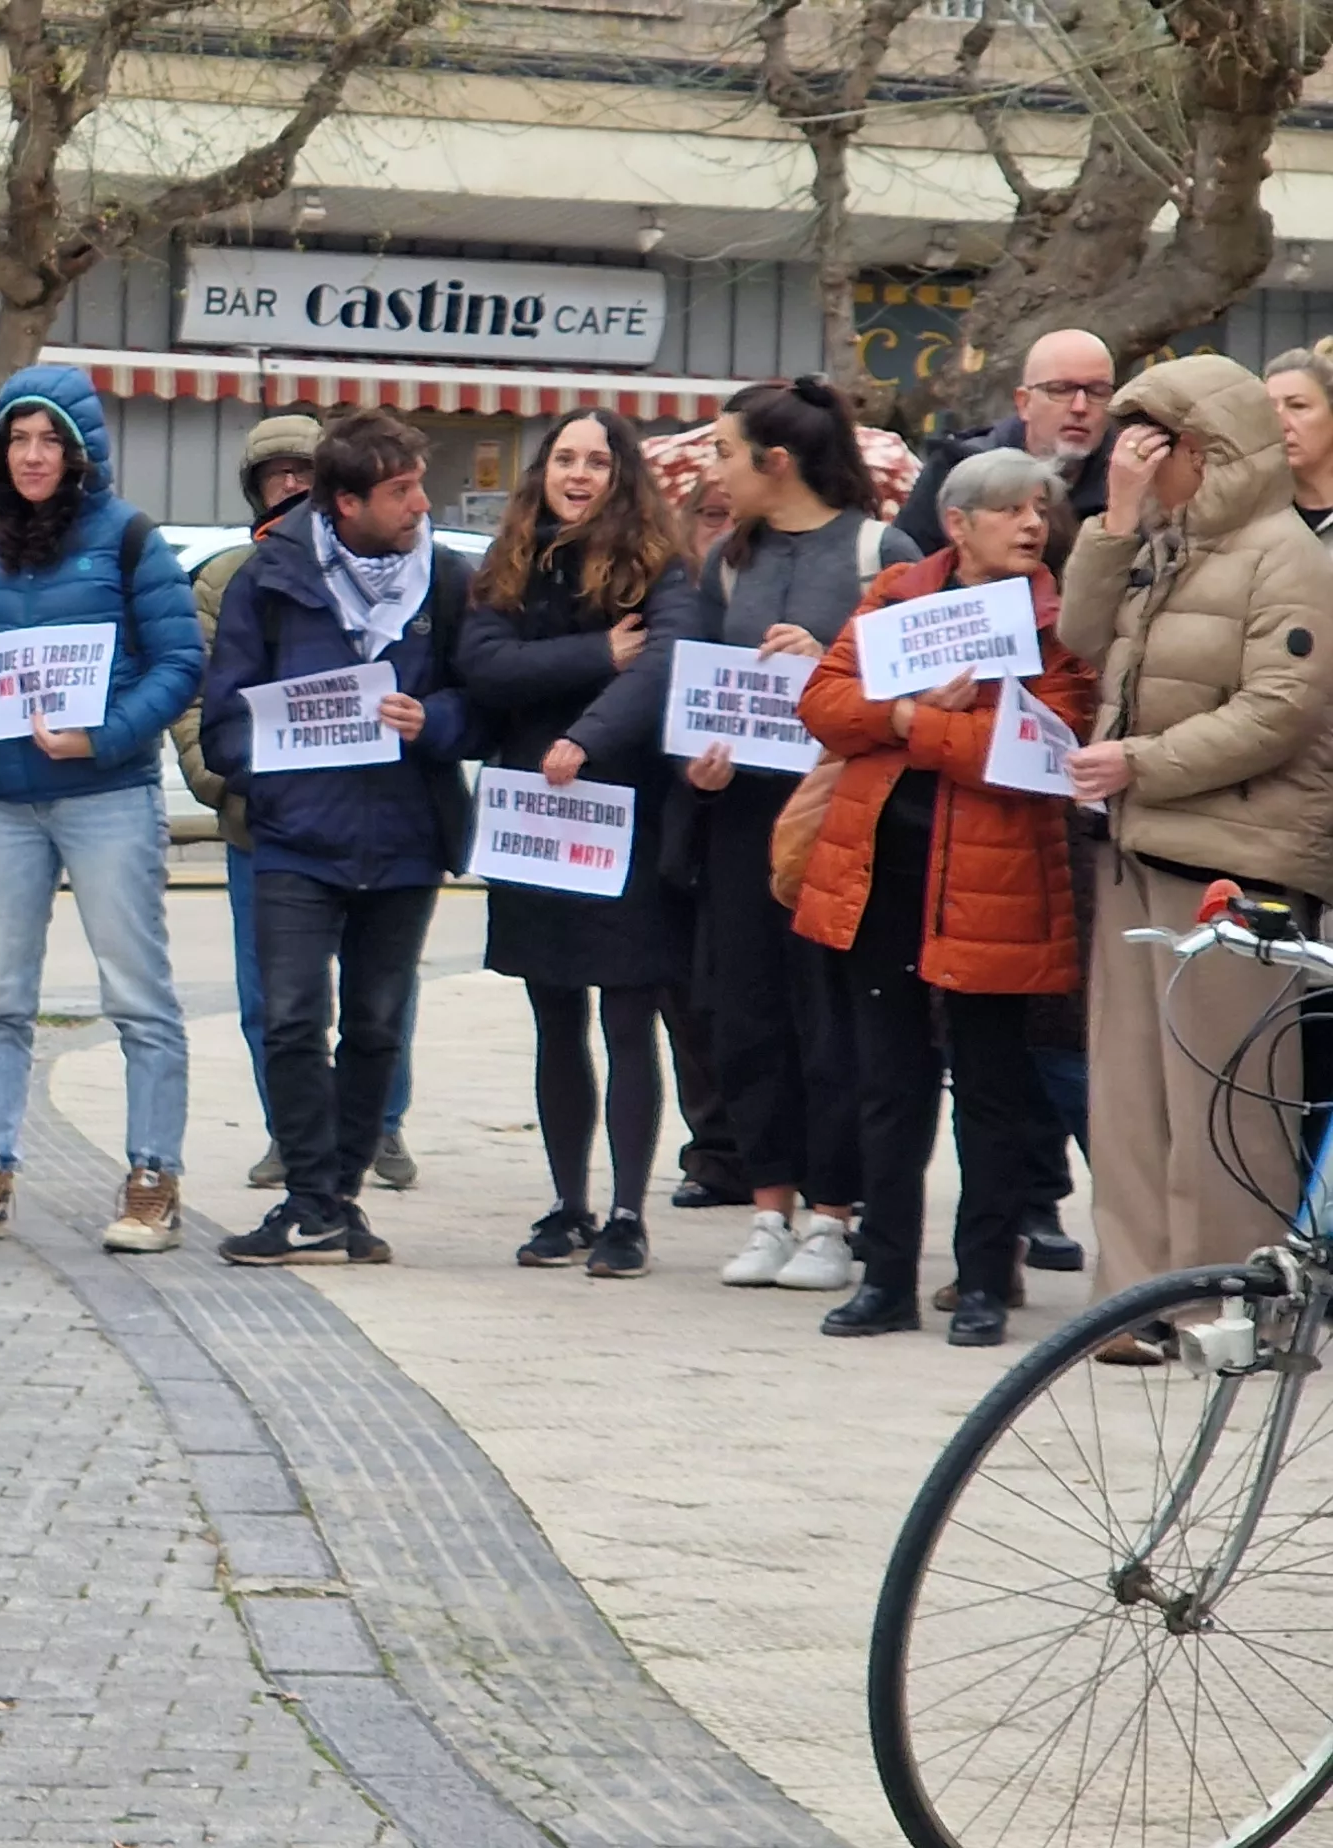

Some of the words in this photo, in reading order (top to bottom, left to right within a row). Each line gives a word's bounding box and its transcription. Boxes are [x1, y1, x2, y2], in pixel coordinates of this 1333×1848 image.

[203, 286, 277, 318] BAR
[305, 278, 547, 339] casting
[553, 300, 648, 336] CAFÉ
[900, 600, 985, 632] EXIGIMOS
[902, 618, 992, 653] DERECHOS
[22, 647, 35, 667] EL
[42, 643, 105, 664] TRABAJO
[889, 662, 899, 678] Y
[908, 632, 1017, 674] PROTECCIÓN
[19, 671, 41, 694] NOS
[45, 666, 99, 688] CUESTE
[285, 674, 359, 698] EXIGIMOS
[715, 667, 731, 686] LA
[737, 670, 769, 692] VIDA
[774, 676, 791, 696] DE
[287, 696, 362, 722] DERECHOS
[685, 688, 711, 707] LAS
[717, 691, 745, 712] QUE
[277, 728, 287, 750] Y
[293, 716, 382, 748] PROTECCIÓN
[489, 788, 507, 809] LA
[514, 790, 626, 828] PRECARIEDAD
[492, 830, 561, 862] LABORAL
[569, 842, 615, 869] MATA
